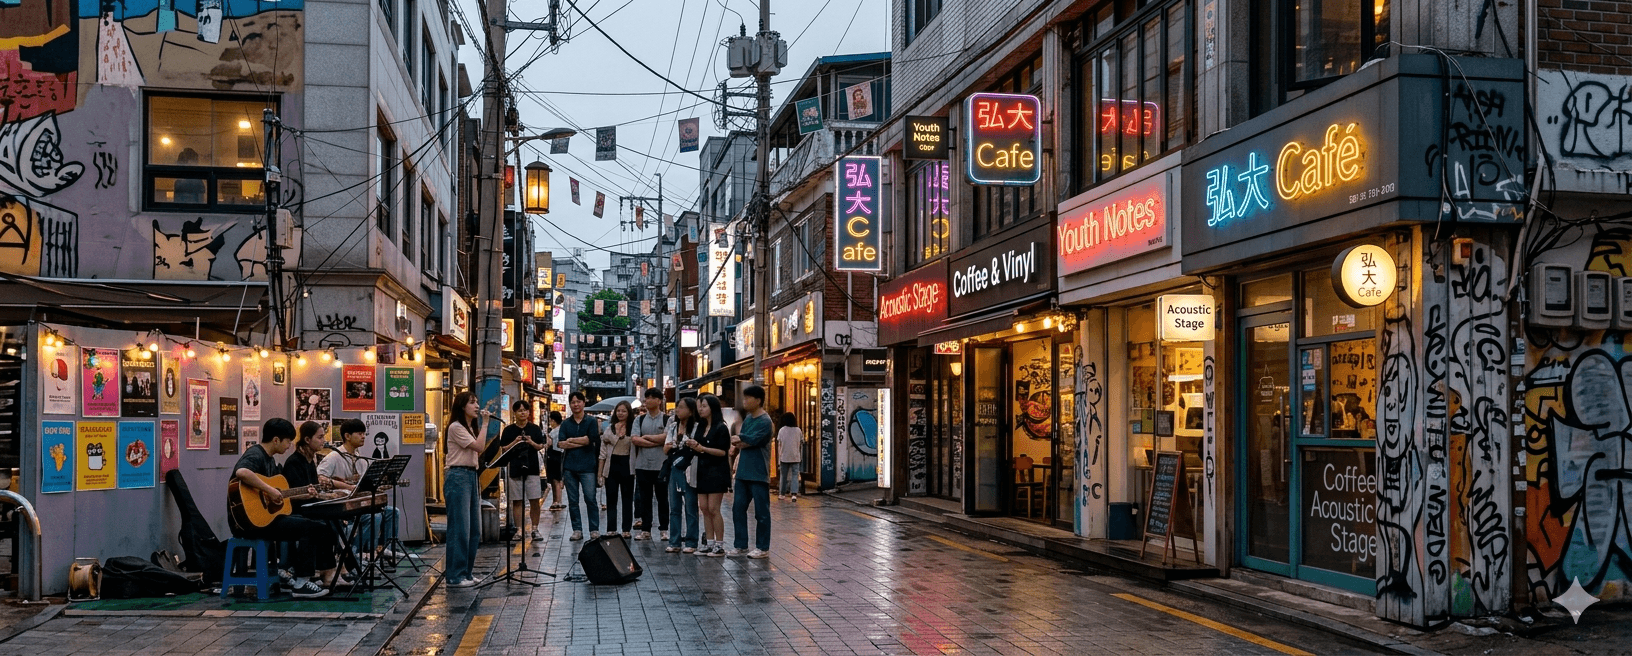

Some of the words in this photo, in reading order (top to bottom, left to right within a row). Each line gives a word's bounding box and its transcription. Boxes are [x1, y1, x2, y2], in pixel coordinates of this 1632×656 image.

[913, 122, 940, 132] Youth
[978, 102, 1034, 130] 弘大
[913, 132, 940, 142] Notes
[977, 143, 1034, 168] Cafe
[844, 163, 872, 215] 弘大
[1206, 152, 1269, 227] 弘大
[1276, 123, 1360, 200] Café
[1057, 211, 1100, 256] Youth
[1103, 198, 1156, 242] Notes
[953, 264, 988, 298] Coffee
[991, 257, 1000, 286] &
[1002, 242, 1035, 284] Vinyl
[1360, 252, 1377, 286] 弘大
[913, 282, 939, 313] Stage
[1358, 286, 1382, 298] Cafe
[1167, 304, 1212, 315] Acoustic
[1174, 318, 1205, 331] Stage
[1323, 462, 1376, 493] Coffee
[1310, 490, 1374, 524] Acoustic
[1330, 522, 1377, 563] Stage
